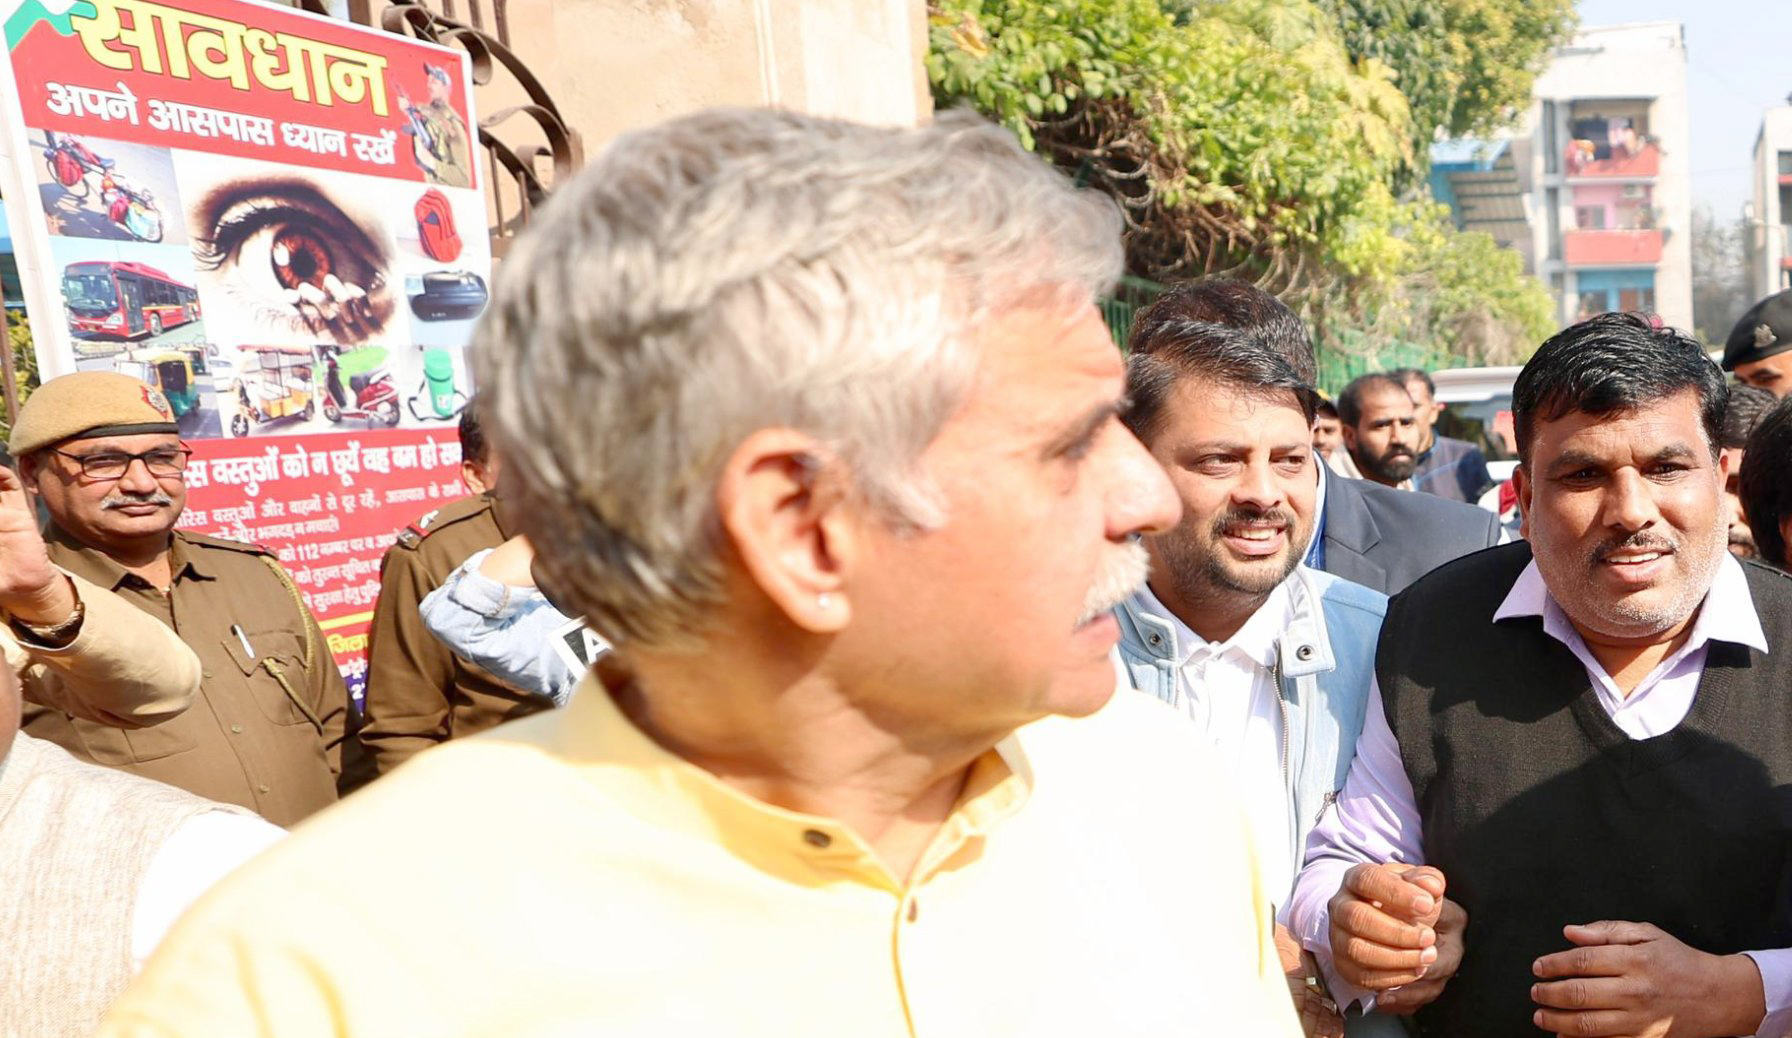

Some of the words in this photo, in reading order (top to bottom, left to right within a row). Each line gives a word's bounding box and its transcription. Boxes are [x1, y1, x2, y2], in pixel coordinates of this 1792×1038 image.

[70, 0, 390, 117] सावधान
[45, 80, 140, 127] अपने
[147, 98, 275, 146] आसपास
[280, 121, 348, 158] ध्यान
[352, 130, 398, 165] रखें
[210, 446, 281, 497] वस्तुओं
[281, 444, 310, 479] को
[310, 452, 329, 475] न
[361, 447, 391, 474] वह
[392, 445, 418, 470] बम
[419, 436, 438, 470] हो
[212, 501, 256, 528] वस्तुओं
[261, 498, 286, 518] और
[289, 493, 323, 516] वाहनों
[326, 492, 339, 511] से
[342, 494, 356, 513] दूर
[279, 543, 297, 562] को
[297, 540, 320, 559] 112
[350, 537, 365, 551] पर
[296, 566, 312, 584] को
